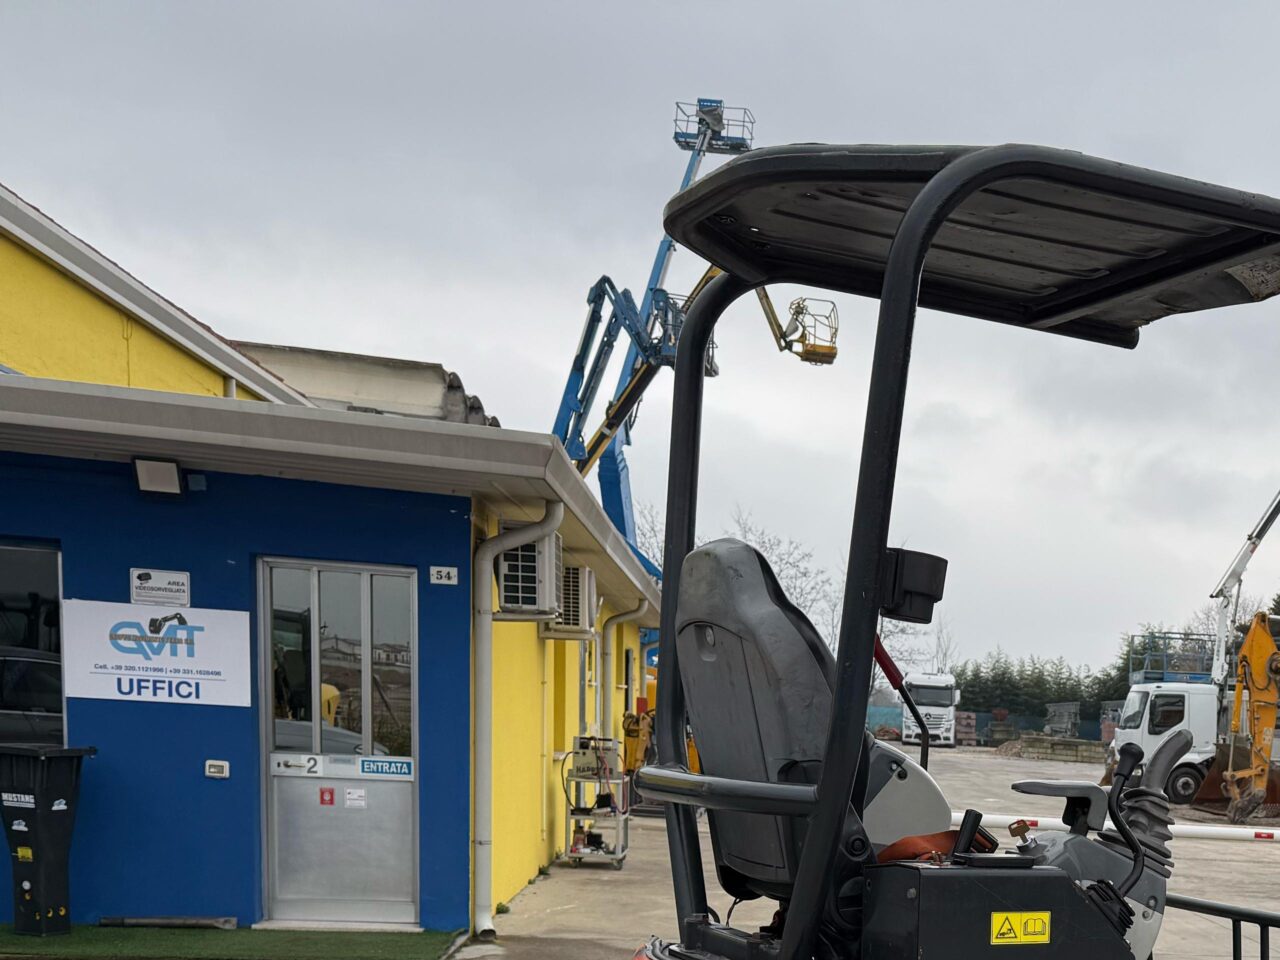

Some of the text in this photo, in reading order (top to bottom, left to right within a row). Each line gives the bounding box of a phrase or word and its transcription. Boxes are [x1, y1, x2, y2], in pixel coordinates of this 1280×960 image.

[436, 570, 452, 581] 54
[116, 677, 200, 699] UFFICI
[306, 757, 318, 774] 2
[363, 761, 409, 774] ENTRATA
[1, 792, 35, 803] MUSTANG
